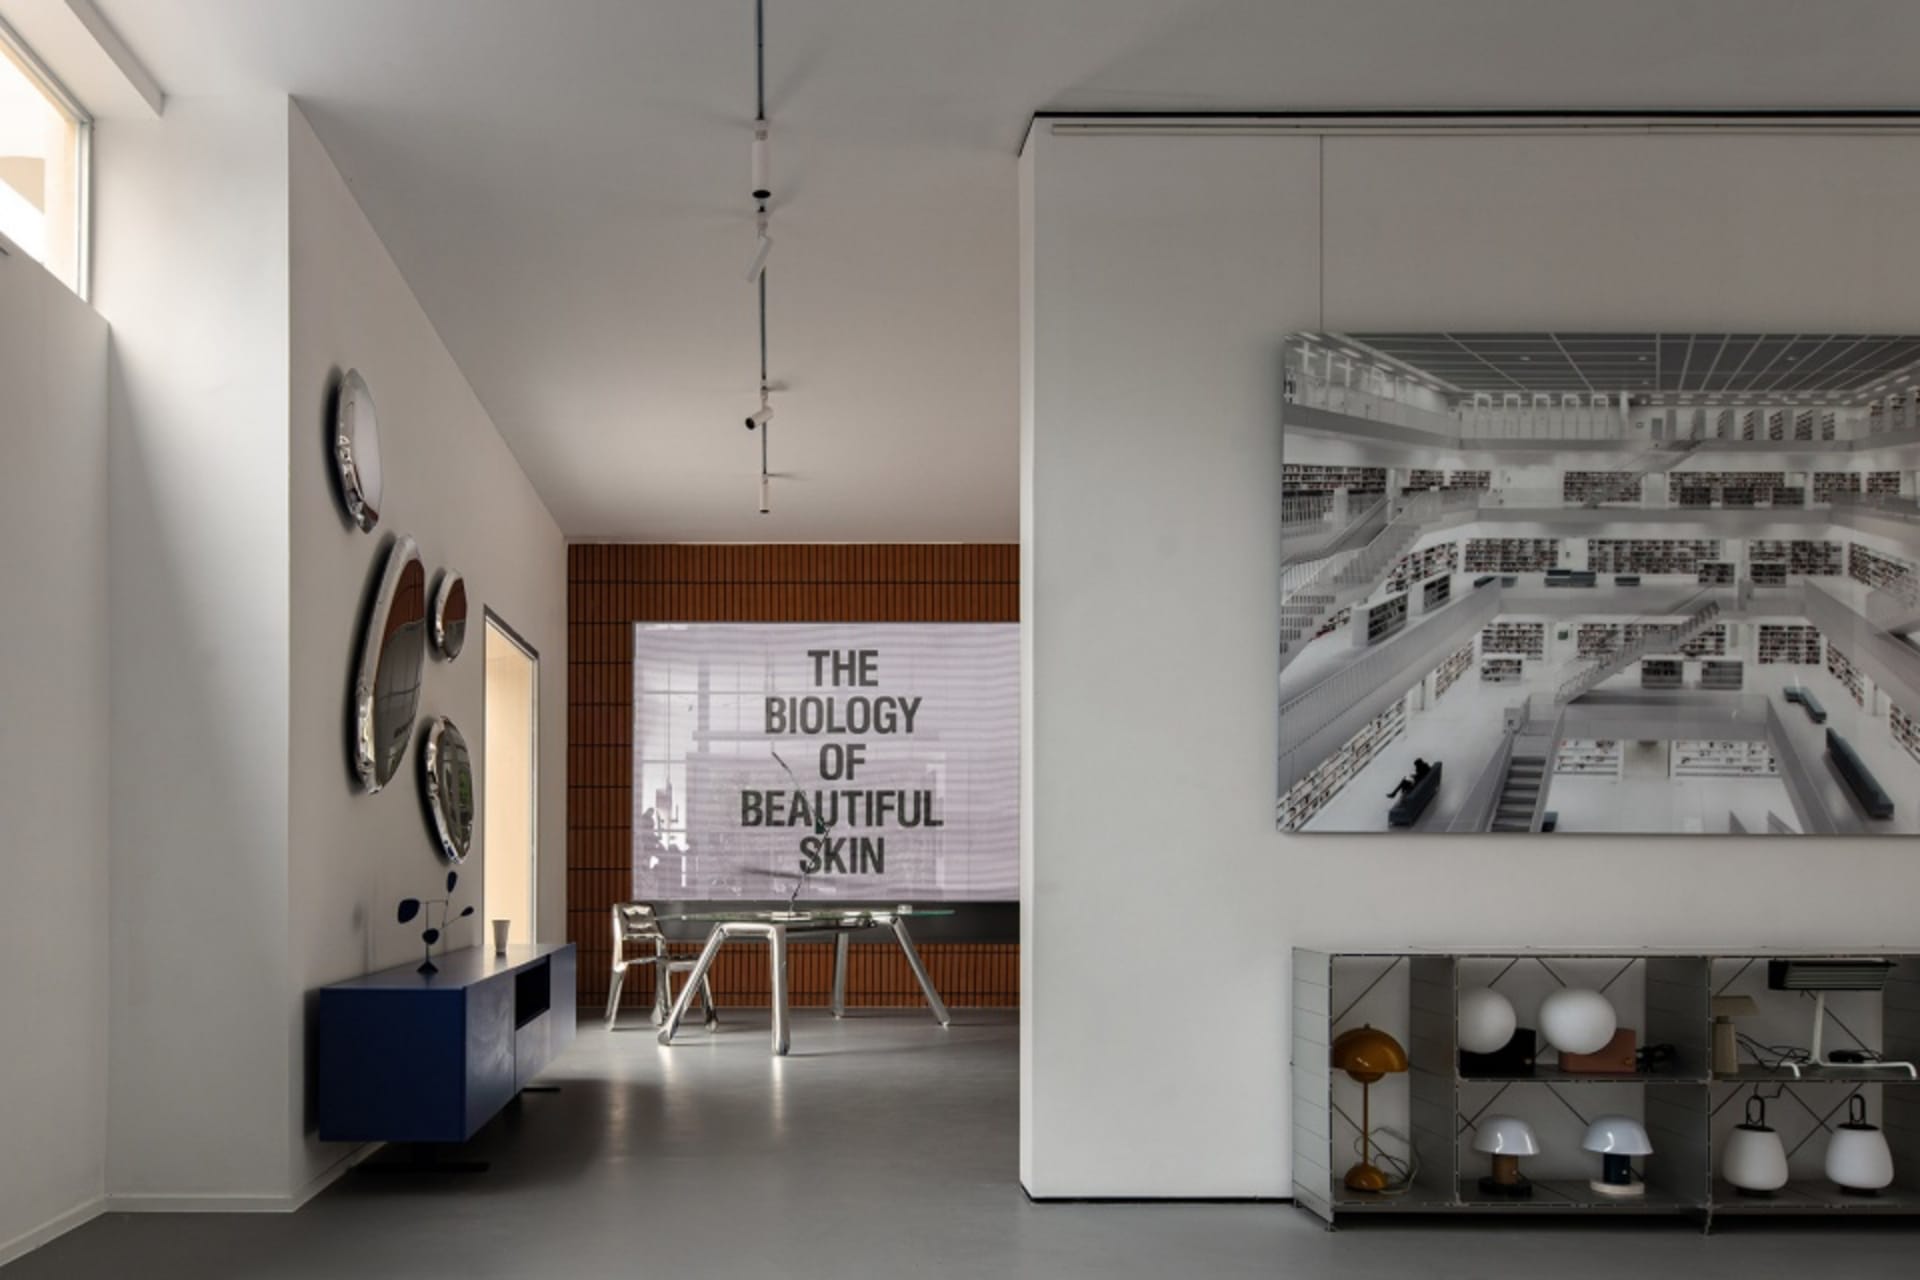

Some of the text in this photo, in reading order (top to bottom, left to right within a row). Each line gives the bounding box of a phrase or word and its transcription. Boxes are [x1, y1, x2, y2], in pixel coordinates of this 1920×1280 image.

[807, 650, 878, 687] THE
[765, 696, 922, 734] BIOLOGY
[819, 743, 866, 780] OF
[741, 790, 943, 828] BEAUTIFUL
[799, 837, 884, 874] SKIN
